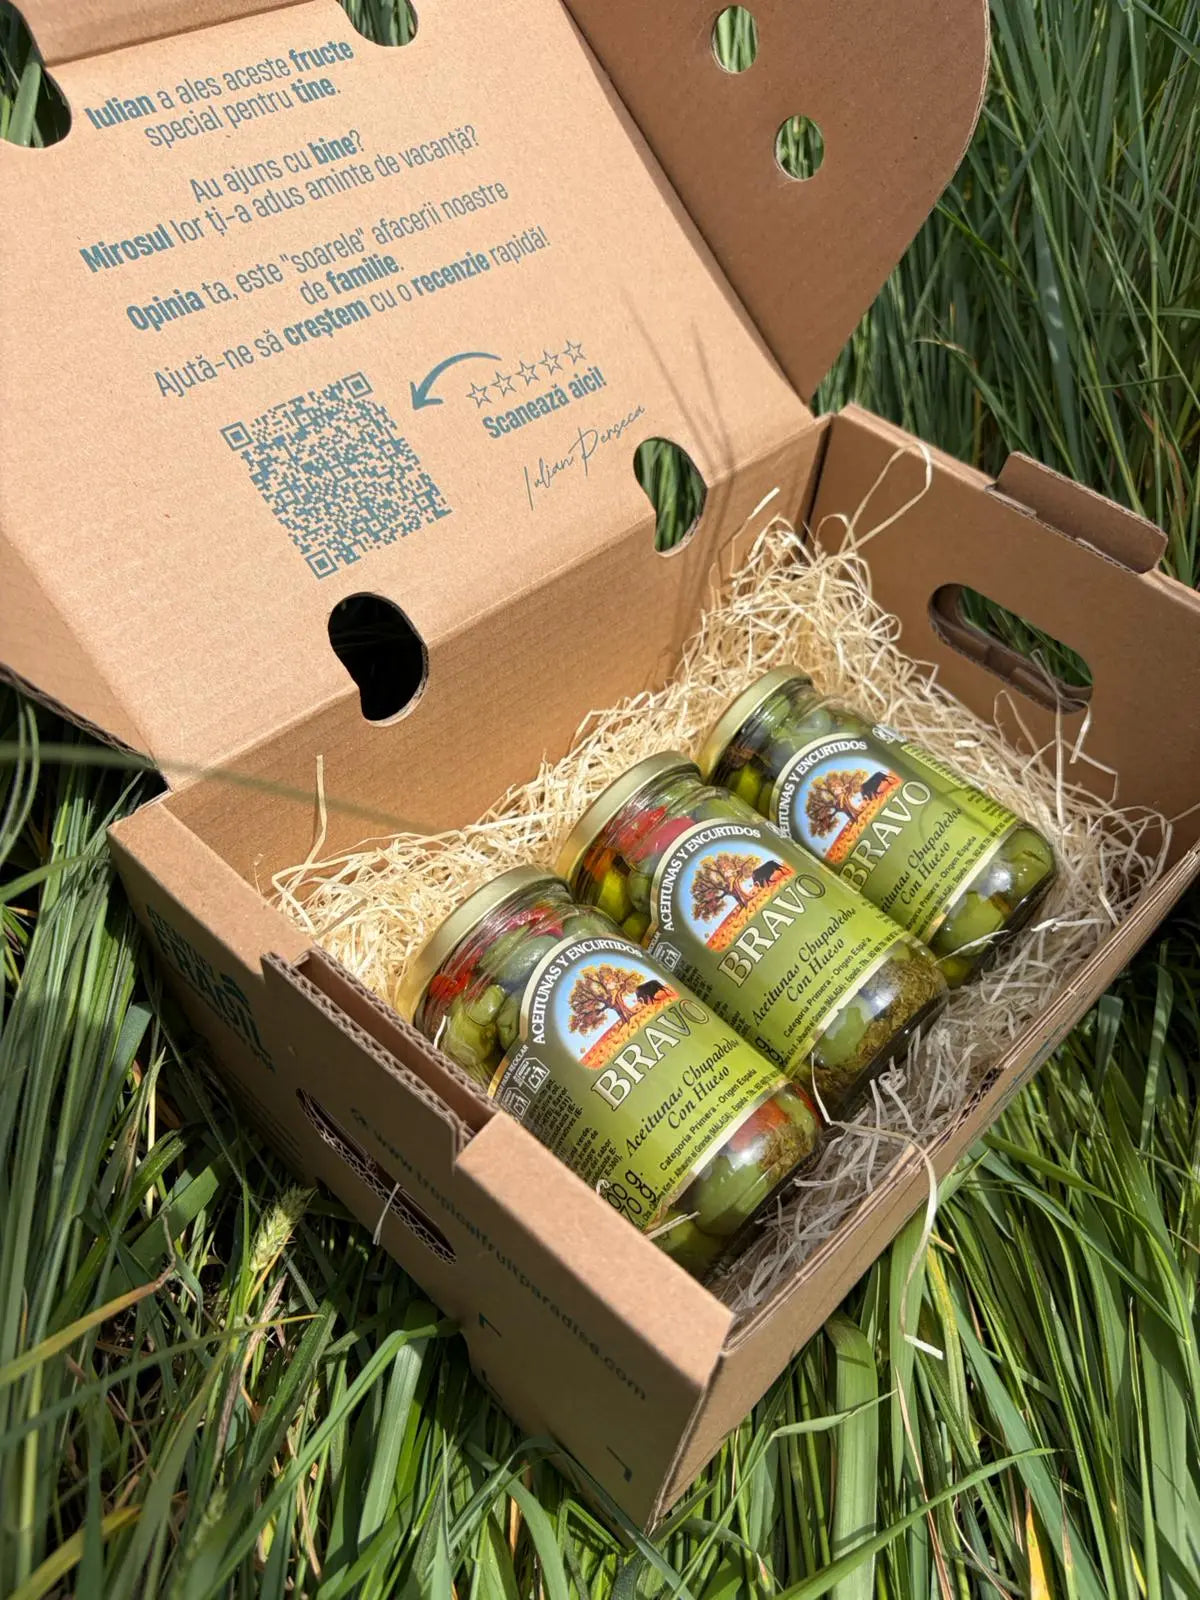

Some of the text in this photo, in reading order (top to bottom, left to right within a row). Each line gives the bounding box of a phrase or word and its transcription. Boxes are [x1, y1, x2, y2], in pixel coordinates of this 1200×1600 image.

[85, 41, 354, 130] Iulian a ales aceste fructe
[144, 78, 341, 149] special pentru tine.
[79, 223, 175, 273] Mirosul
[170, 217, 205, 244] lor
[252, 187, 305, 218] adus
[305, 164, 375, 200] aminte
[374, 153, 401, 177] de
[398, 124, 479, 168] vacanță?
[189, 129, 364, 204] Au ajuns cu bine?
[126, 182, 509, 332] Opinia ta, este "soarele" afacerii noastre
[300, 253, 404, 305] de familie.
[153, 226, 551, 398] Ajută-ne să creștem cu o recenzie rapidă!
[482, 366, 607, 439] Scanează aici!
[788, 772, 800, 782] Y
[795, 740, 868, 775] ENCURTIDOS
[660, 858, 682, 932] ACEITUNAS
[677, 849, 690, 860] Y
[685, 825, 761, 853] ENCURTIDOS
[841, 779, 932, 892] BRAVO
[900, 880, 922, 905] Con
[917, 842, 950, 881] Hueso
[907, 807, 962, 870] Chupadedos
[940, 857, 960, 879] Origen
[717, 872, 826, 988] BRAVO
[752, 964, 800, 1027] Aceitunas
[798, 908, 856, 963] Chupadedos
[786, 938, 844, 1002] Con Hueso
[531, 964, 562, 1045] ACEITUNAS
[556, 955, 570, 968] Y
[565, 939, 644, 961] ENCURTIDOS
[806, 979, 832, 1006] Primera
[832, 955, 854, 976] Origen
[591, 998, 711, 1112] BRAVO
[626, 1086, 683, 1158] Aceitunas
[682, 1038, 740, 1089] Chupadedos
[667, 1066, 729, 1130] Con Hueso
[659, 1134, 692, 1171] Categoria
[689, 1106, 717, 1135] Primera
[718, 1083, 740, 1104] Origen
